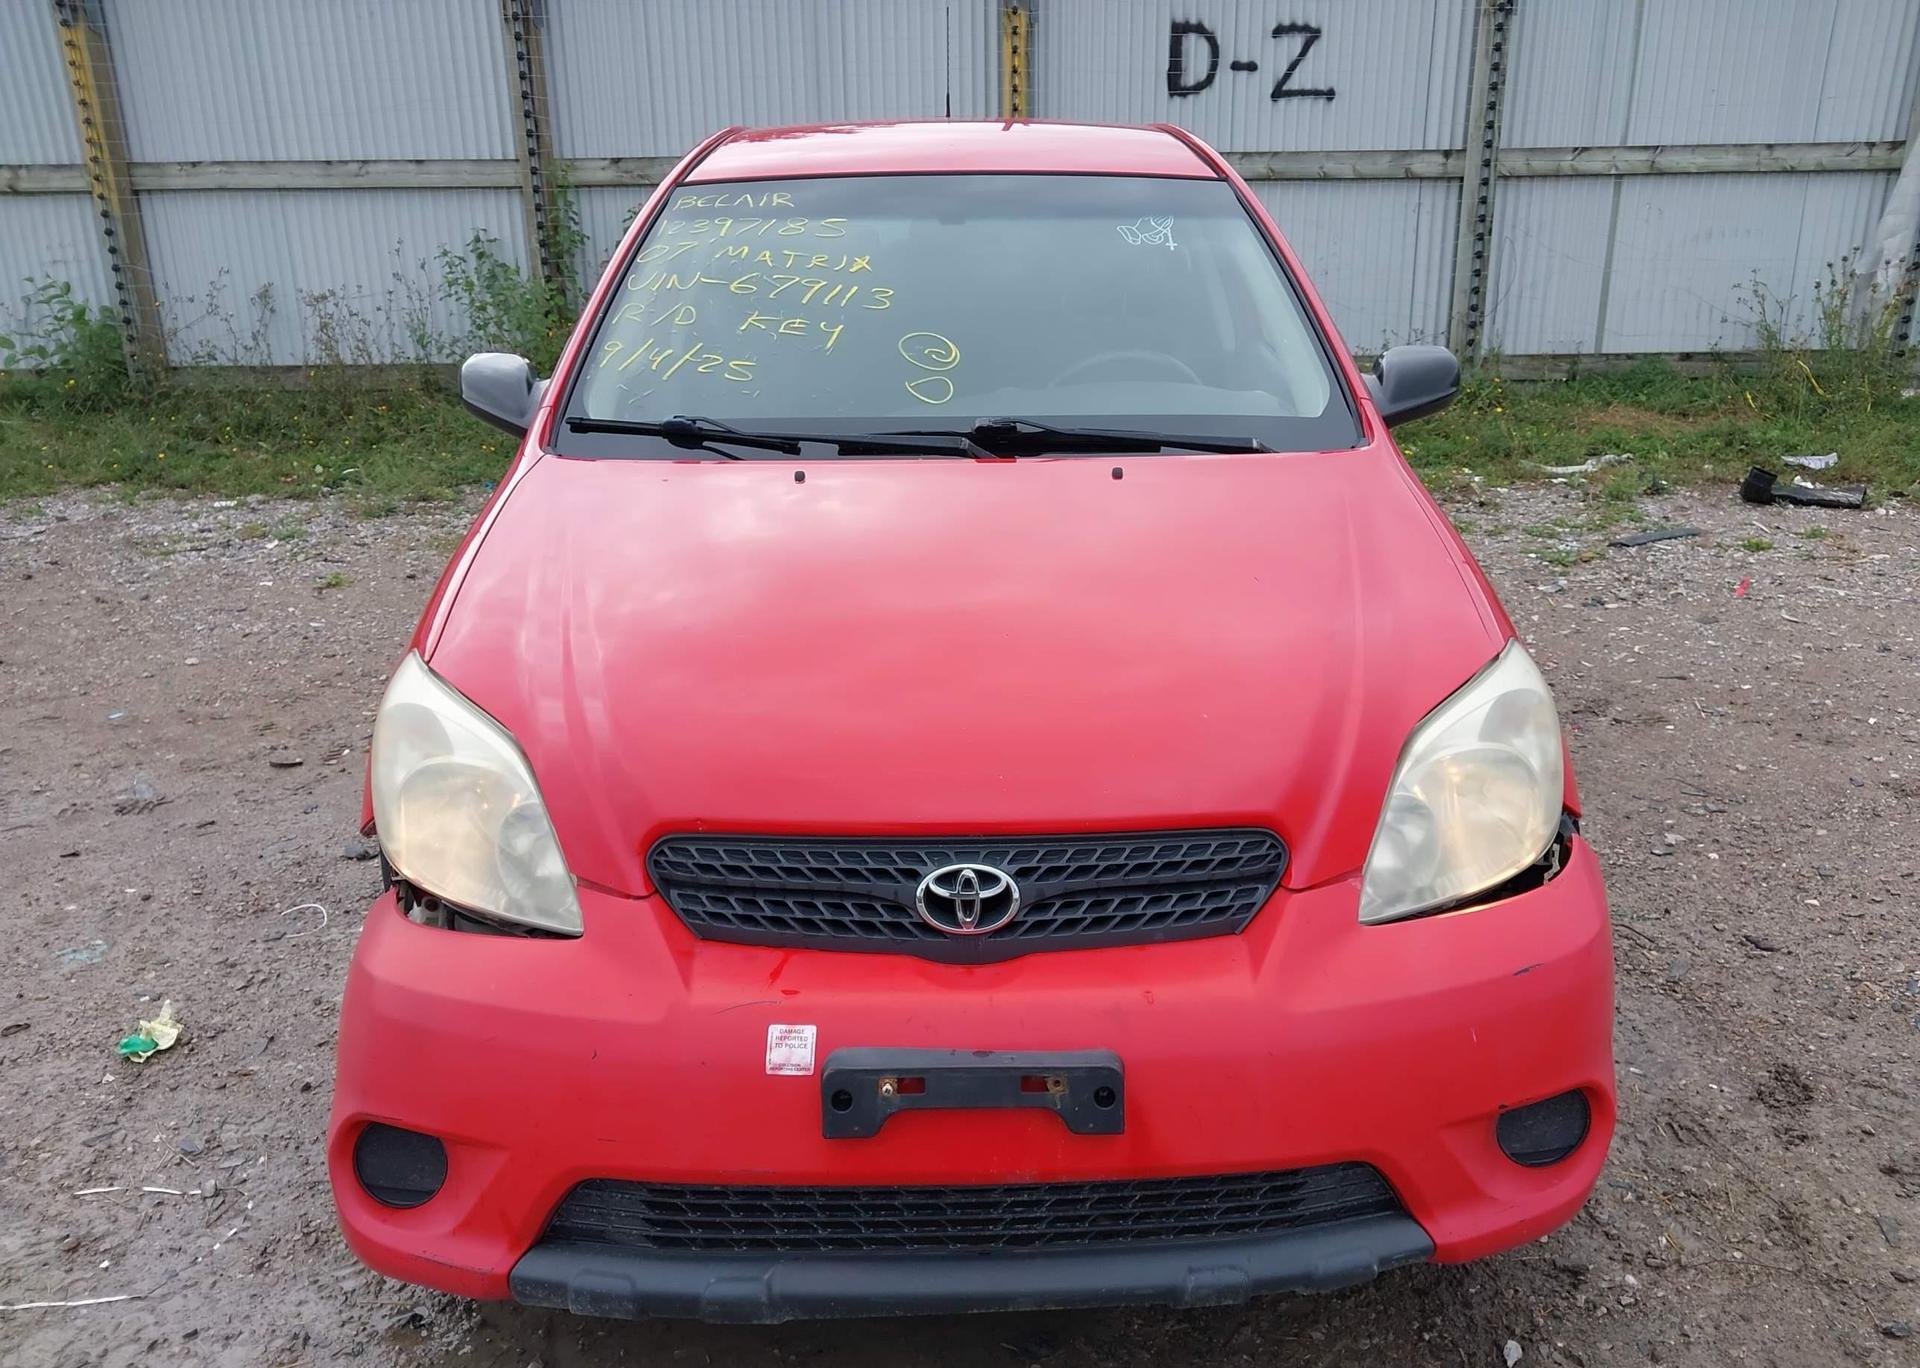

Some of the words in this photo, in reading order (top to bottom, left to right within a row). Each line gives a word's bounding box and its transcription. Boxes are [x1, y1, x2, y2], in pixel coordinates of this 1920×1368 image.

[1167, 18, 1336, 102] D-Z
[656, 216, 849, 238] 12397185
[713, 245, 873, 273] MATRIX
[740, 310, 845, 351] KEY
